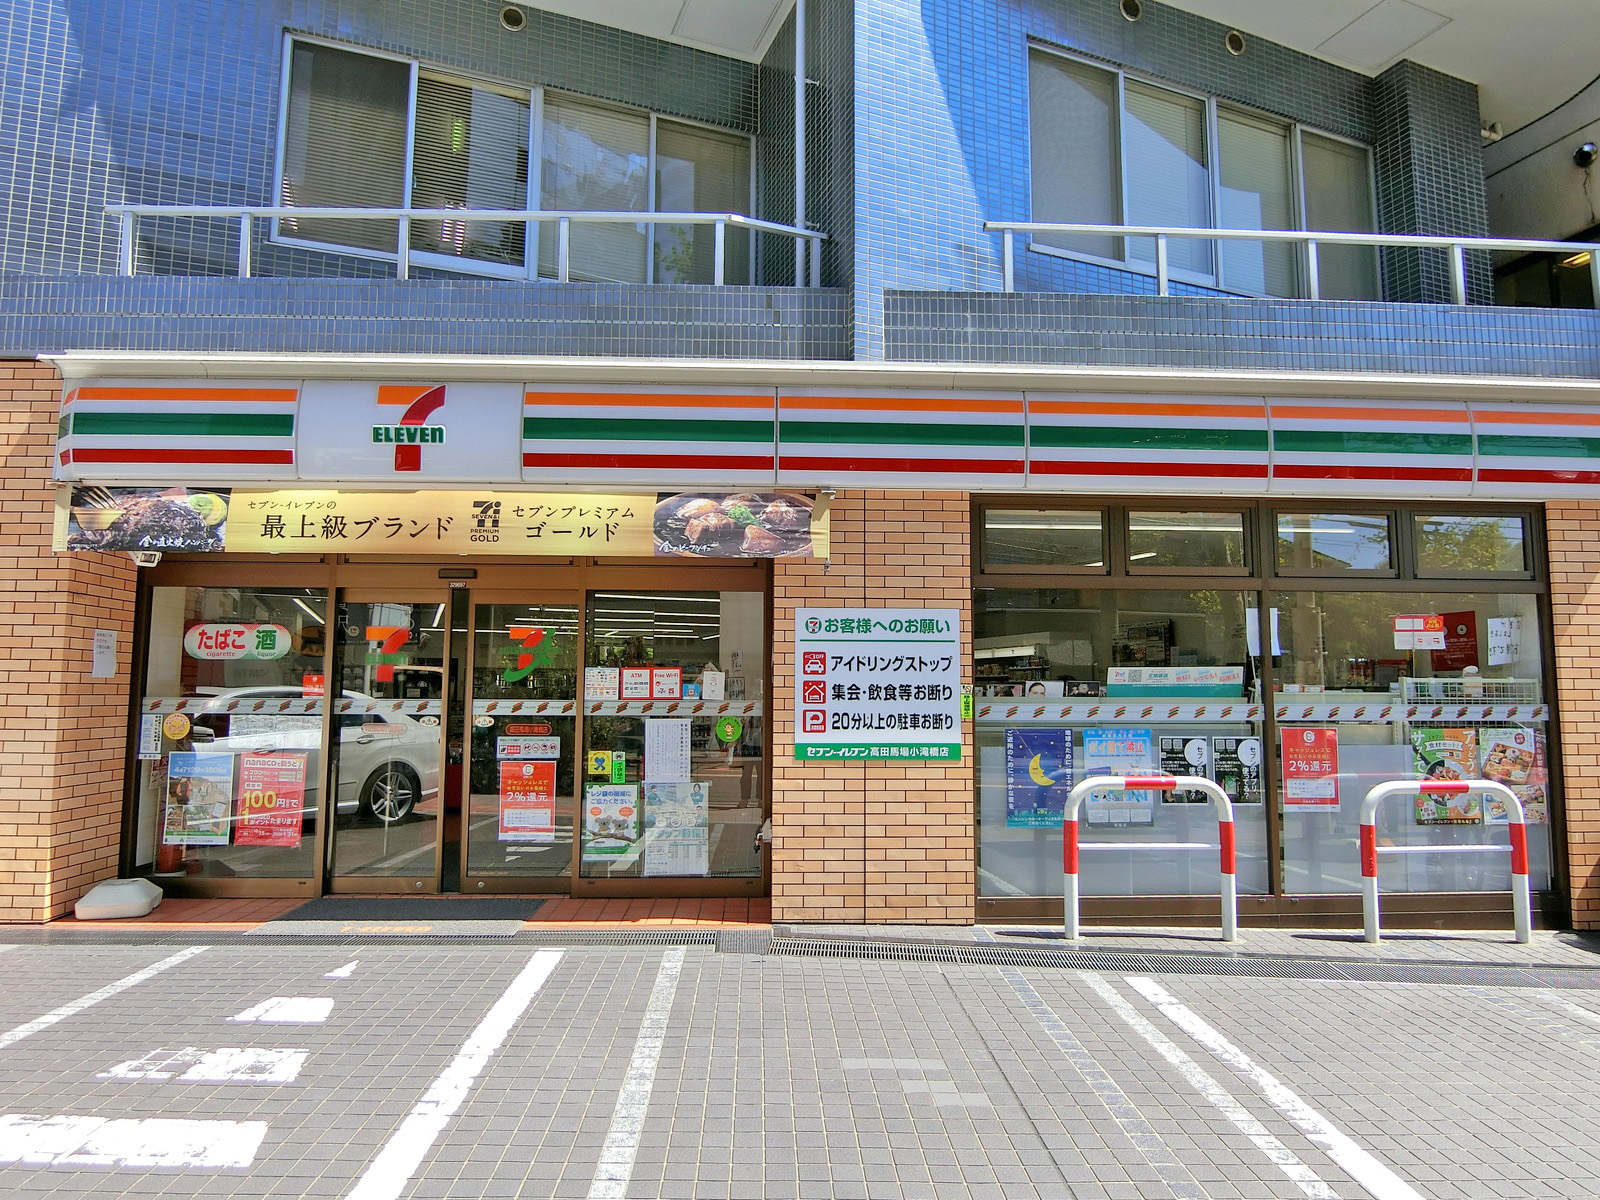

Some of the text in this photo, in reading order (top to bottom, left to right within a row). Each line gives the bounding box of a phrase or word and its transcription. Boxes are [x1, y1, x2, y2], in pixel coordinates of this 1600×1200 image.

[512, 505, 634, 520] セブンプレミアム
[261, 514, 454, 540] 最上級ブランド
[526, 521, 619, 542] ゴールド
[470, 534, 500, 543] GOLD
[824, 617, 950, 633] お客様へのお願い
[197, 629, 277, 650] たばこ 酒
[831, 655, 953, 672] アイドリングストップ
[831, 684, 953, 701] 集会・飲食等お断り
[832, 712, 953, 730] 20分以上の駐車お断り
[870, 747, 949, 757] 高田馬場小滝橋店
[1289, 760, 1332, 771] 2%還元
[506, 791, 549, 802] 2%還元
